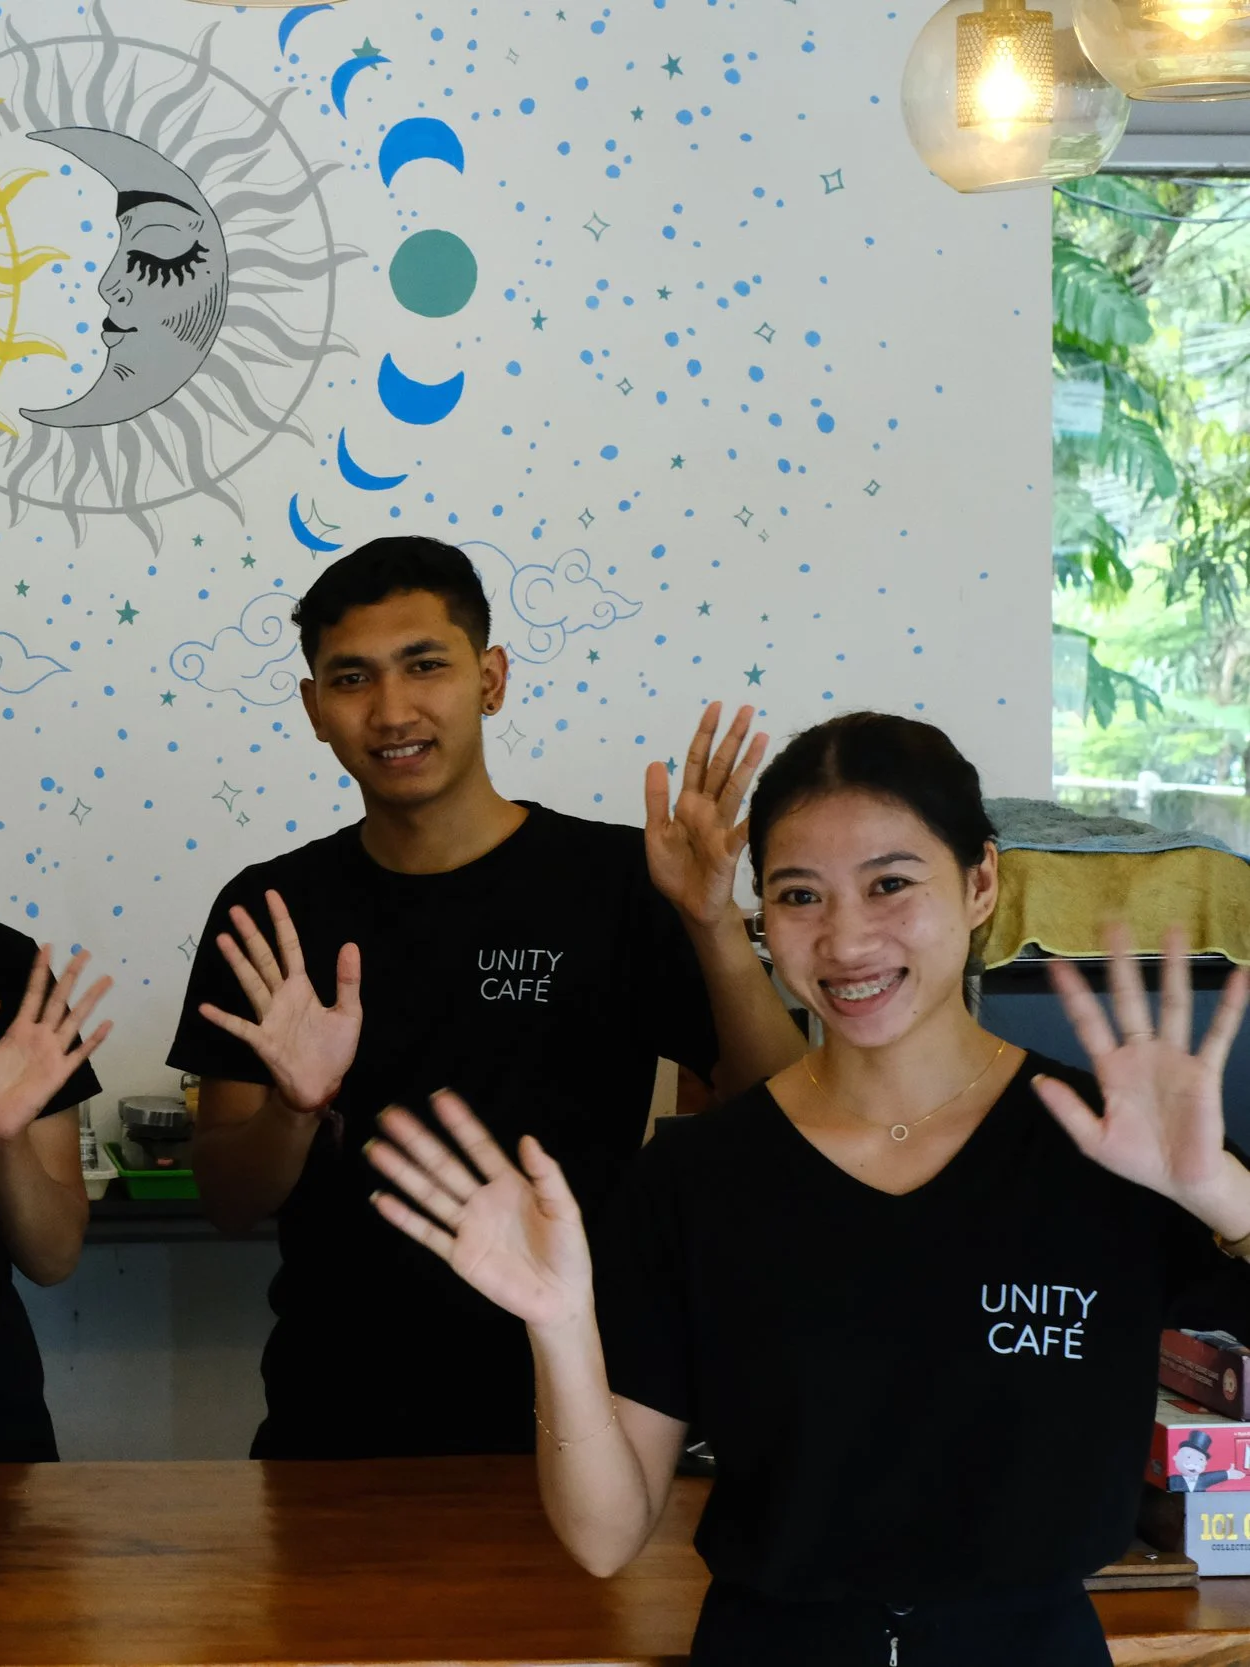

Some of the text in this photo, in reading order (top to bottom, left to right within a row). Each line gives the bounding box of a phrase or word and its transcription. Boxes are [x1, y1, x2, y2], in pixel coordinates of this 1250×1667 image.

[478, 949, 564, 972] UNITY
[480, 974, 551, 1002] CAFÉ
[981, 1284, 1098, 1319] UNITY
[988, 1321, 1085, 1359] CAFÉ
